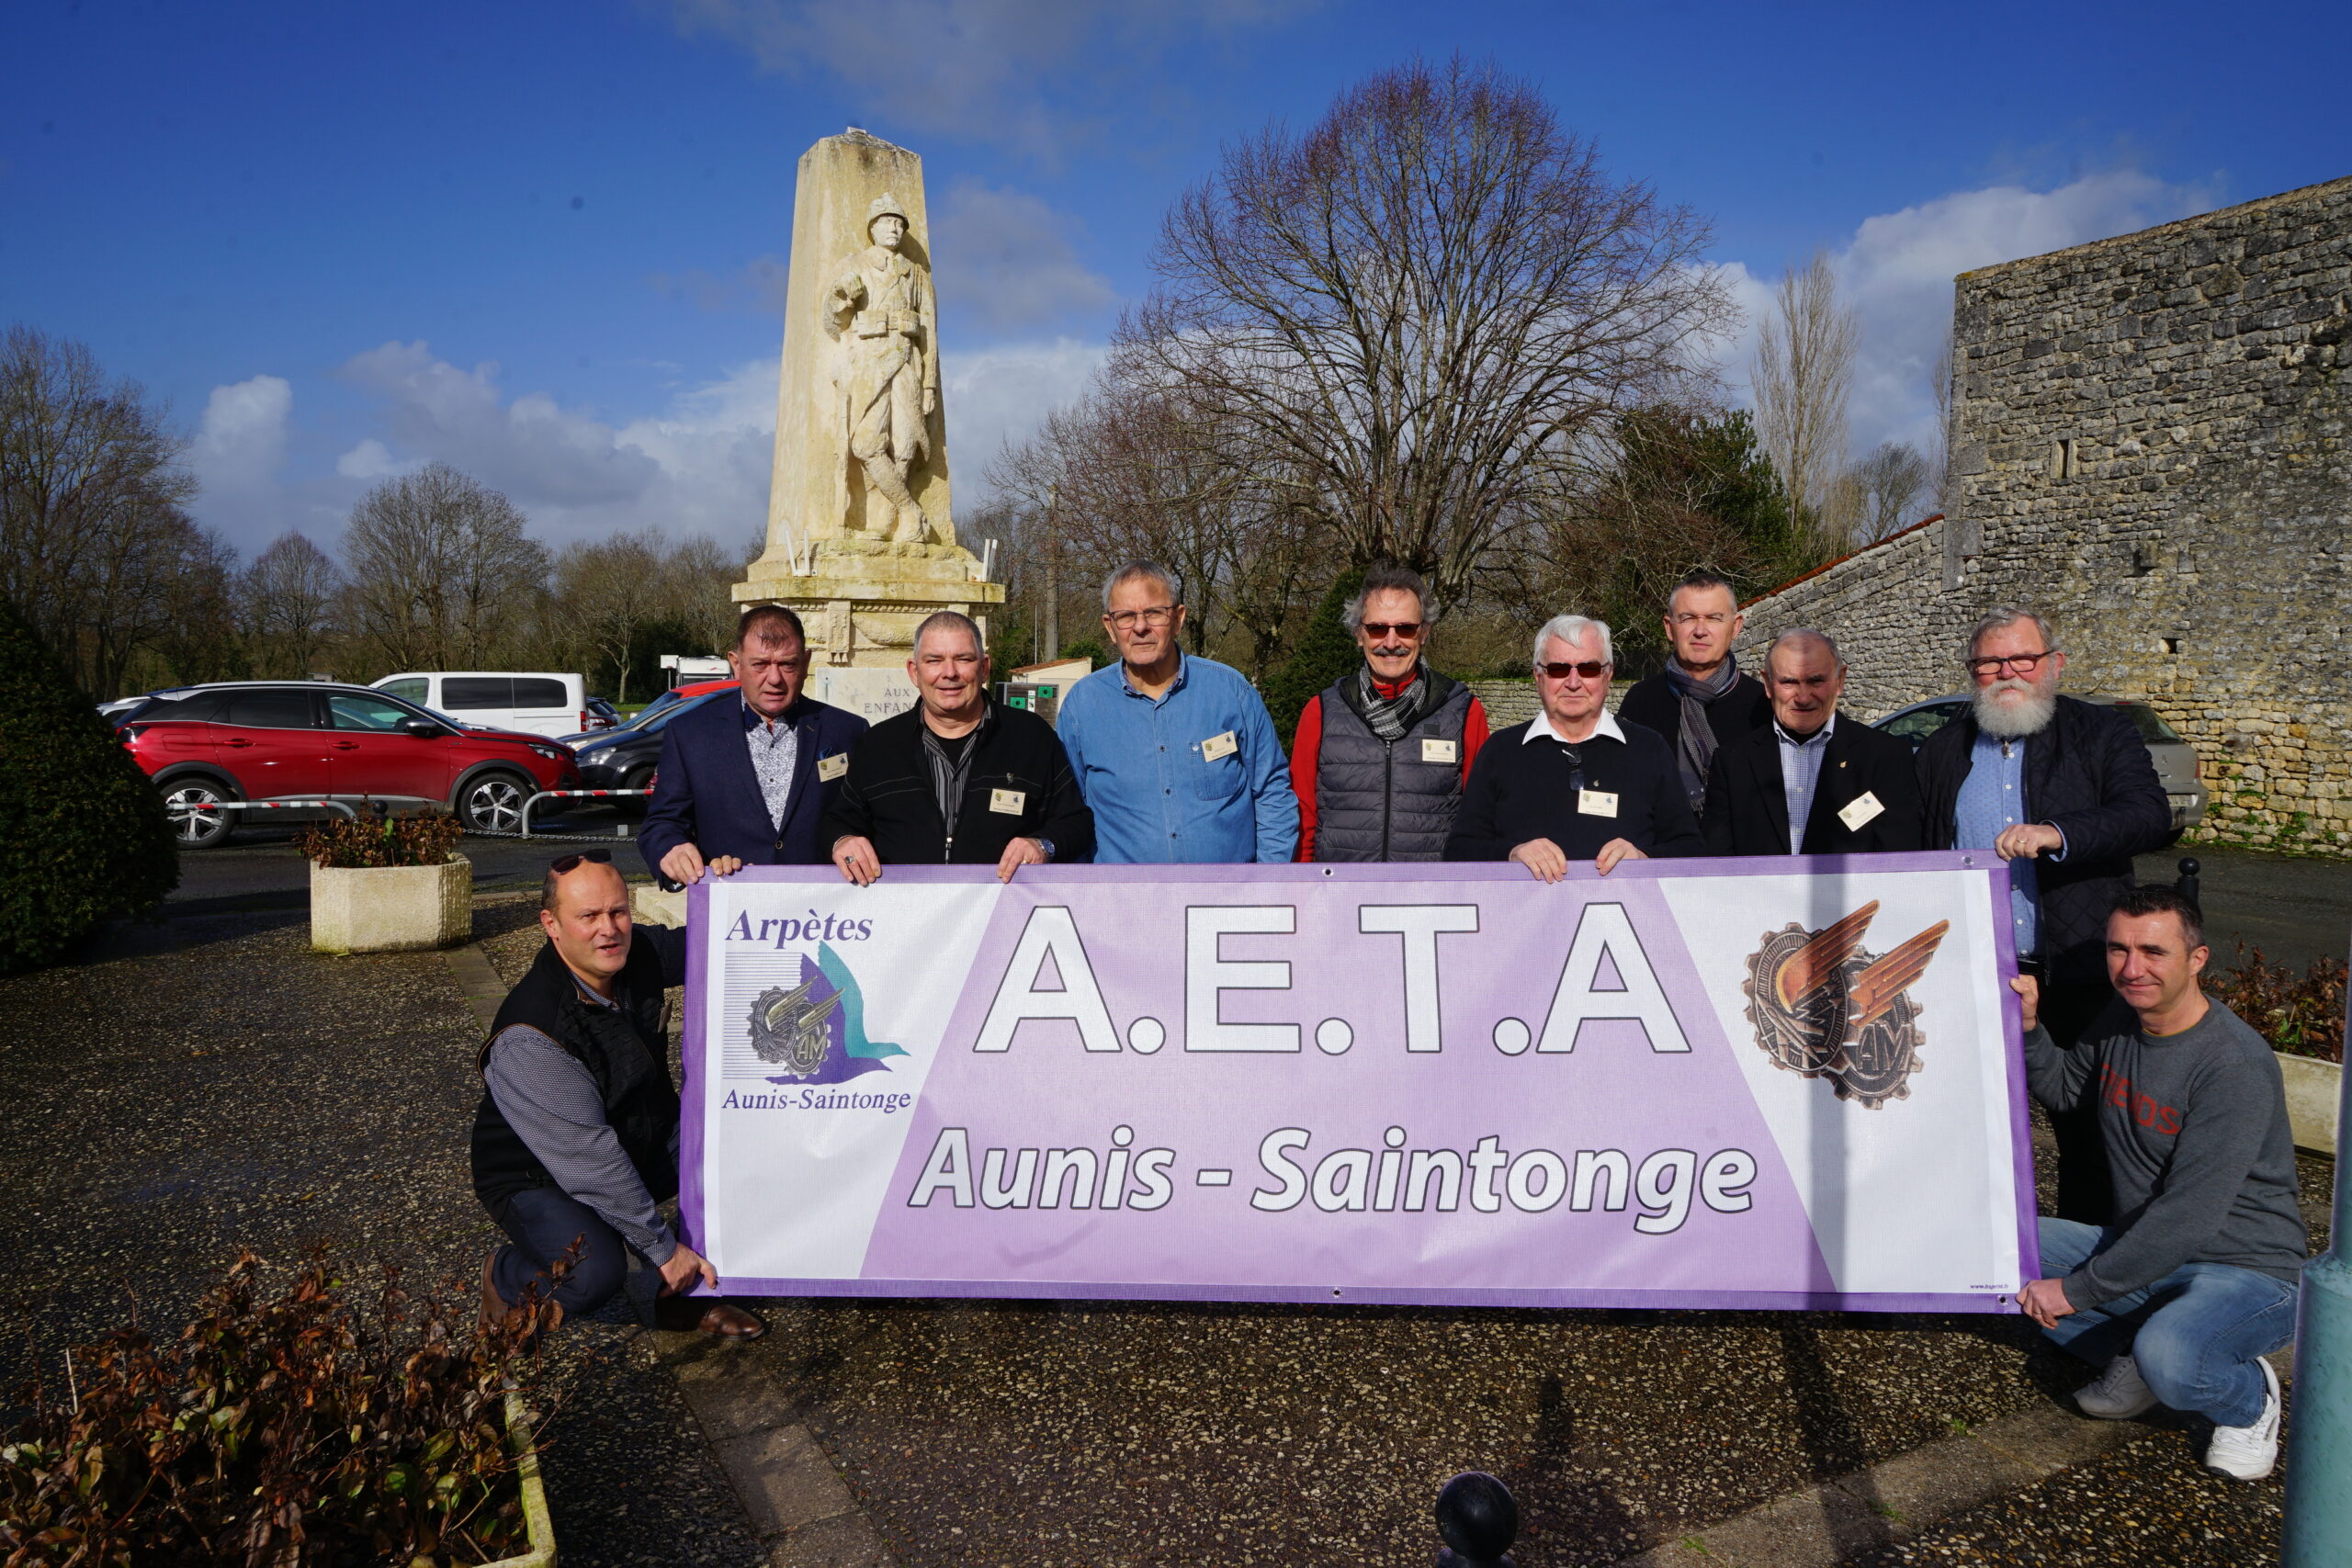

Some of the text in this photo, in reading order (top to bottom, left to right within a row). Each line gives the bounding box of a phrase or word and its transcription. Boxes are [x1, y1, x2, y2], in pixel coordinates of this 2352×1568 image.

[865, 703, 915, 714] ENFAN
[884, 688, 910, 697] AUX
[725, 908, 873, 950] Arpètes
[972, 902, 1693, 1056] A.E.T.A
[796, 1033, 826, 1060] AM
[1857, 1020, 1912, 1071] AM
[722, 1088, 911, 1114] Aunis-Saintonge
[907, 1123, 1175, 1212] Aunis
[1250, 1124, 1758, 1235] Saintonge
